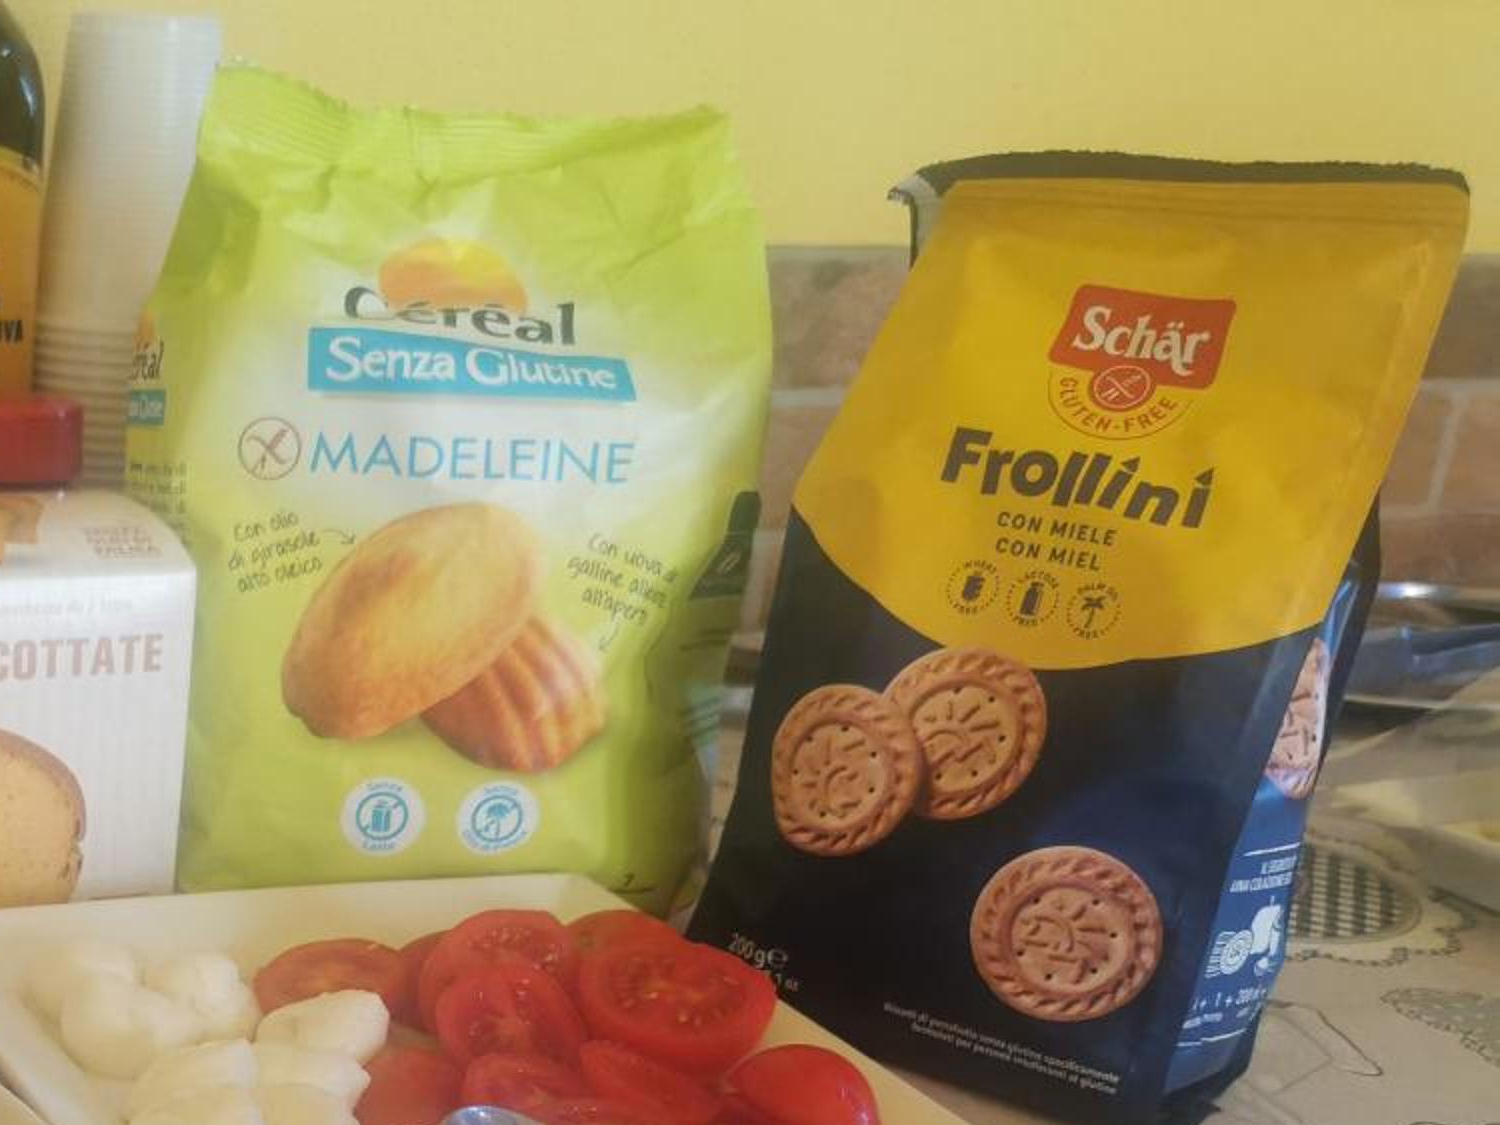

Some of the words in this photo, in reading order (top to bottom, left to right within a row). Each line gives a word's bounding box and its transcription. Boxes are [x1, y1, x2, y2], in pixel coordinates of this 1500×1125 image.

[325, 335, 455, 382] Senza
[466, 347, 616, 390] Glutine
[1071, 305, 1211, 377] Schär
[1060, 376, 1178, 433] GLUTEN-FREE
[310, 431, 635, 483] MADELEINE
[940, 426, 1215, 529] Frollini
[996, 538, 1040, 559] CON
[1048, 547, 1100, 571] MIEL
[997, 511, 1042, 533] CON
[1050, 522, 1117, 546] MIELE
